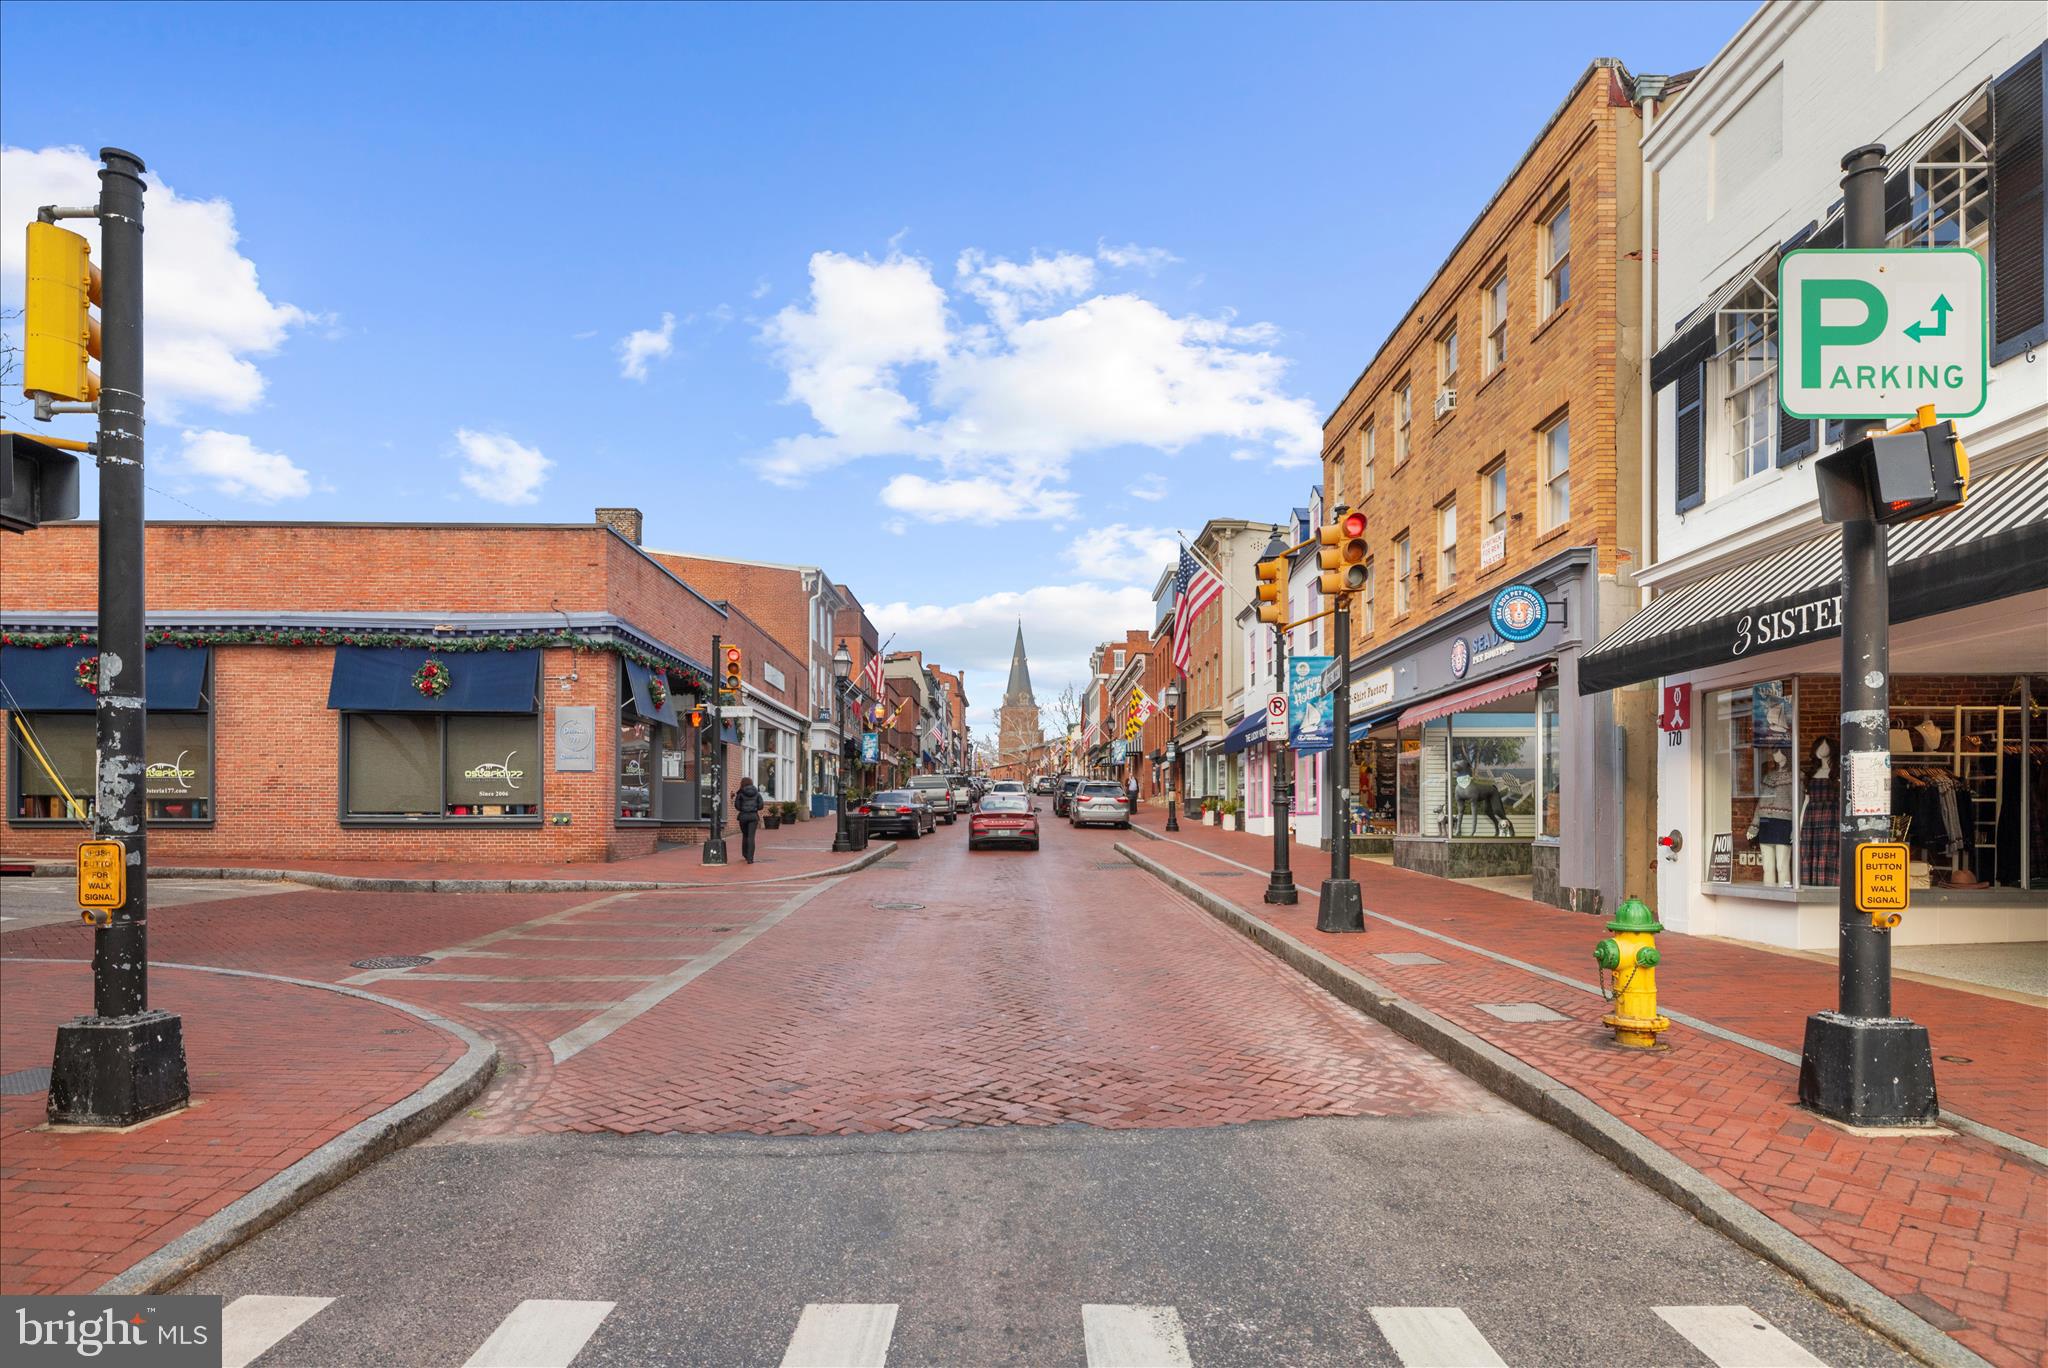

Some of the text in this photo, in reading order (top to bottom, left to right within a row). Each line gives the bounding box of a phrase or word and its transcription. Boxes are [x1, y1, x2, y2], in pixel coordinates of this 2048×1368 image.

[1801, 279, 1964, 389] PARKING
[1499, 594, 1510, 606] DOG
[1523, 591, 1541, 618] BOUTIQUE
[1733, 595, 1842, 655] 3 SISTE
[1472, 633, 1491, 654] SEA
[1669, 731, 1682, 747] 170
